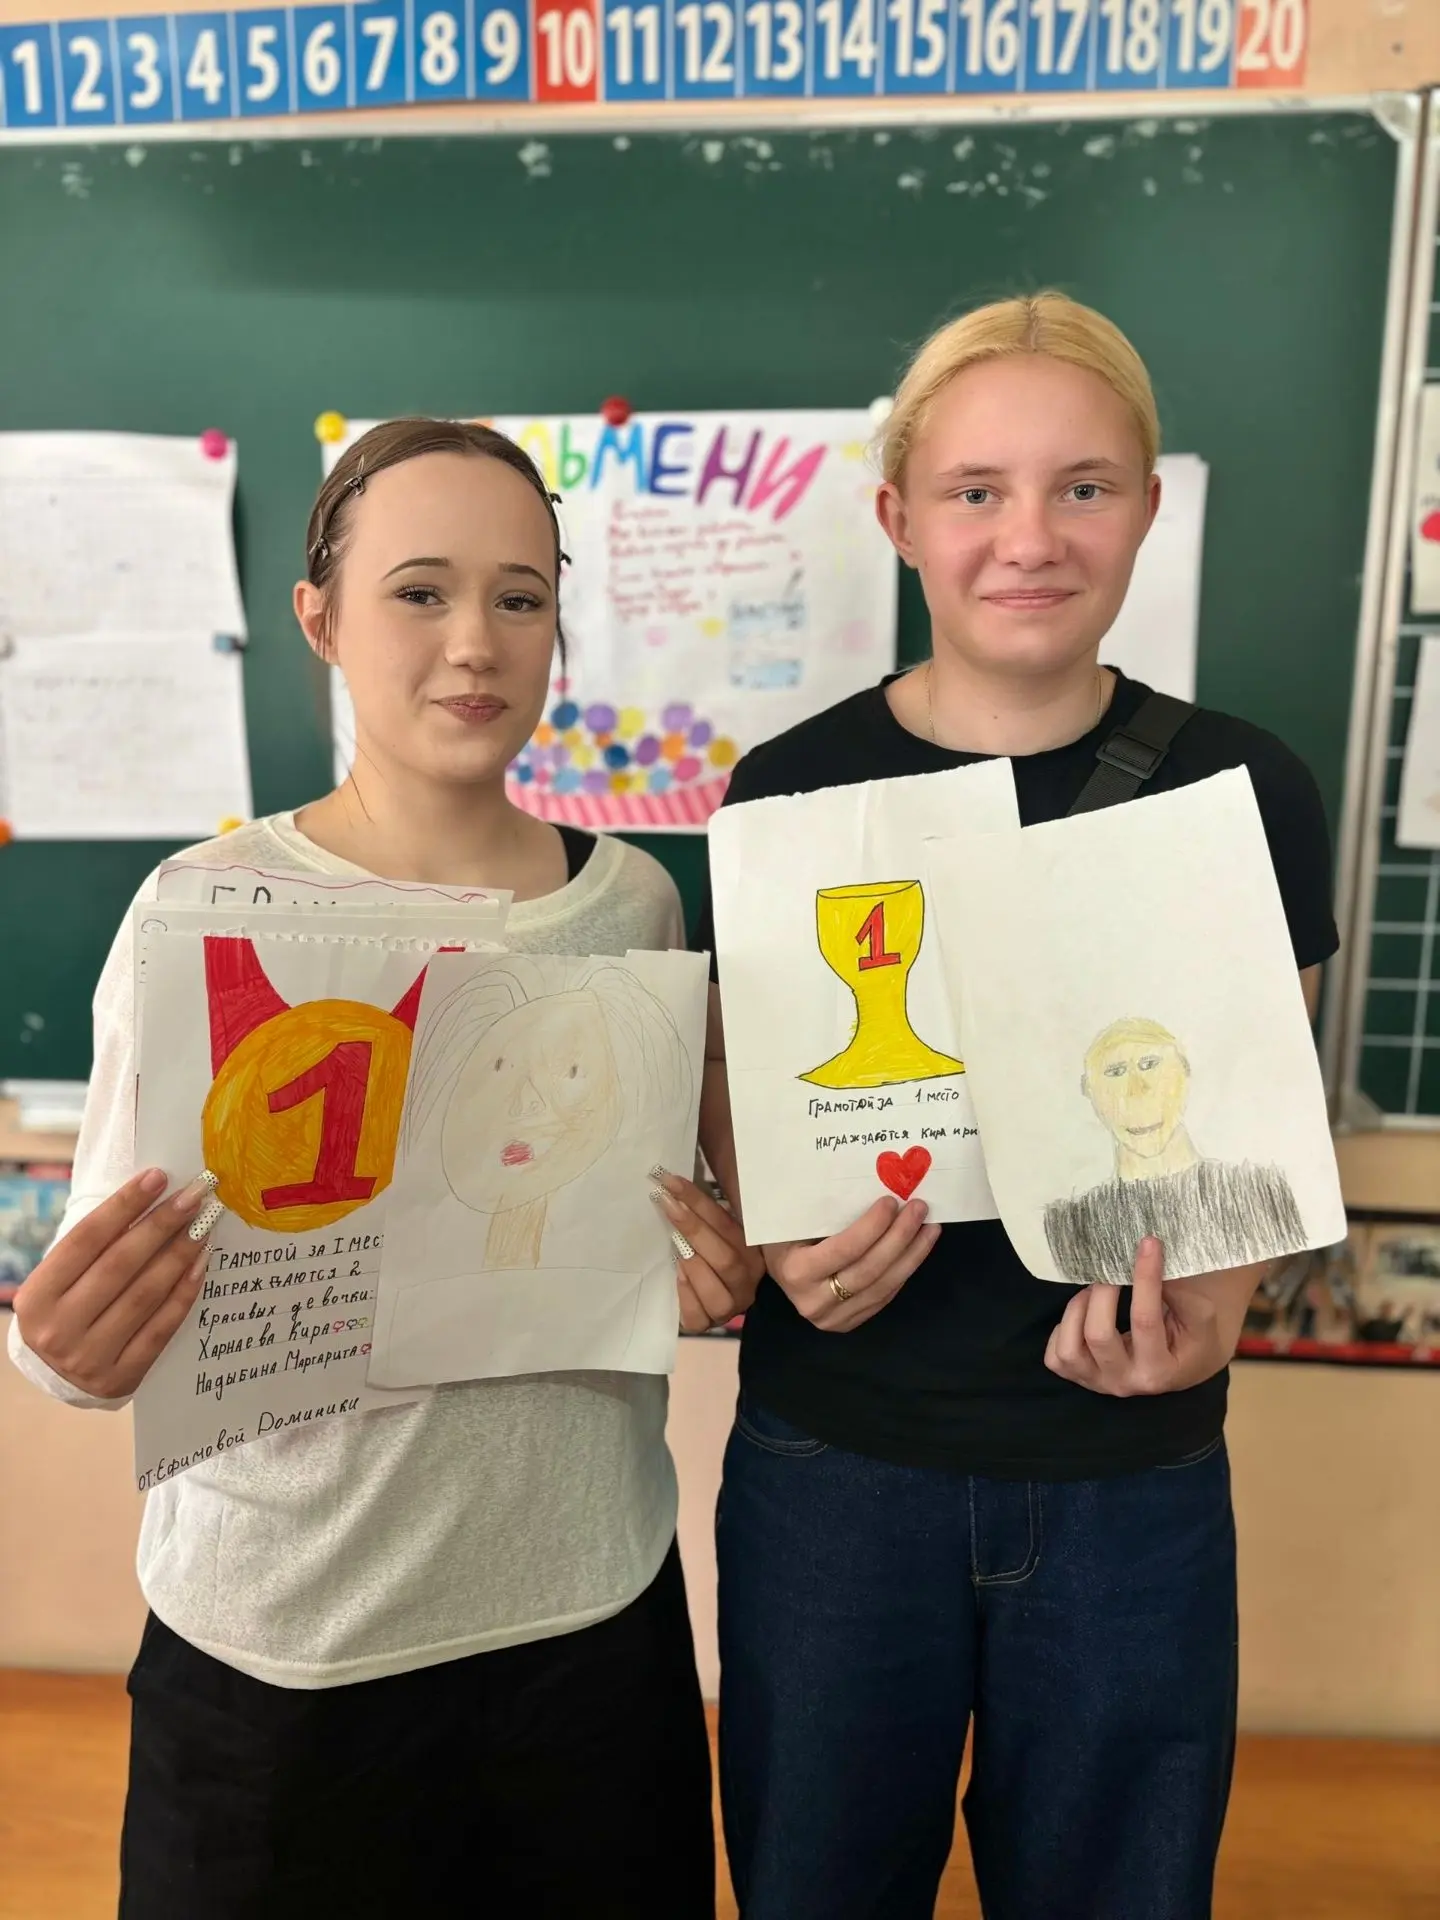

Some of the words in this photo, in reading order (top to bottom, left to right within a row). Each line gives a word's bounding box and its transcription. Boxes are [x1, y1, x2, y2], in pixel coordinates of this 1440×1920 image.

[12, 39, 42, 114] 1
[68, 35, 106, 112] 2
[127, 31, 163, 109] 3
[185, 28, 224, 104] 4
[247, 25, 280, 101] 5
[302, 21, 341, 96] 6
[361, 17, 398, 91] 7
[421, 11, 459, 86] 8
[482, 11, 521, 85] 9
[538, 8, 598, 88] 10
[607, 5, 660, 86] 11
[675, 3, 733, 82] 12
[746, 2, 803, 81] 13
[815, 0, 877, 79] 14
[888, 0, 947, 78] 15
[958, 0, 1018, 76] 16
[1028, 0, 1090, 75] 17
[1100, 0, 1161, 75] 18
[1171, 0, 1231, 73] 19
[1237, 0, 1303, 71] 20
[855, 901, 901, 972] 1
[261, 1041, 377, 1210] 1
[914, 1088, 922, 1103] 1
[349, 1260, 362, 1277] 2
